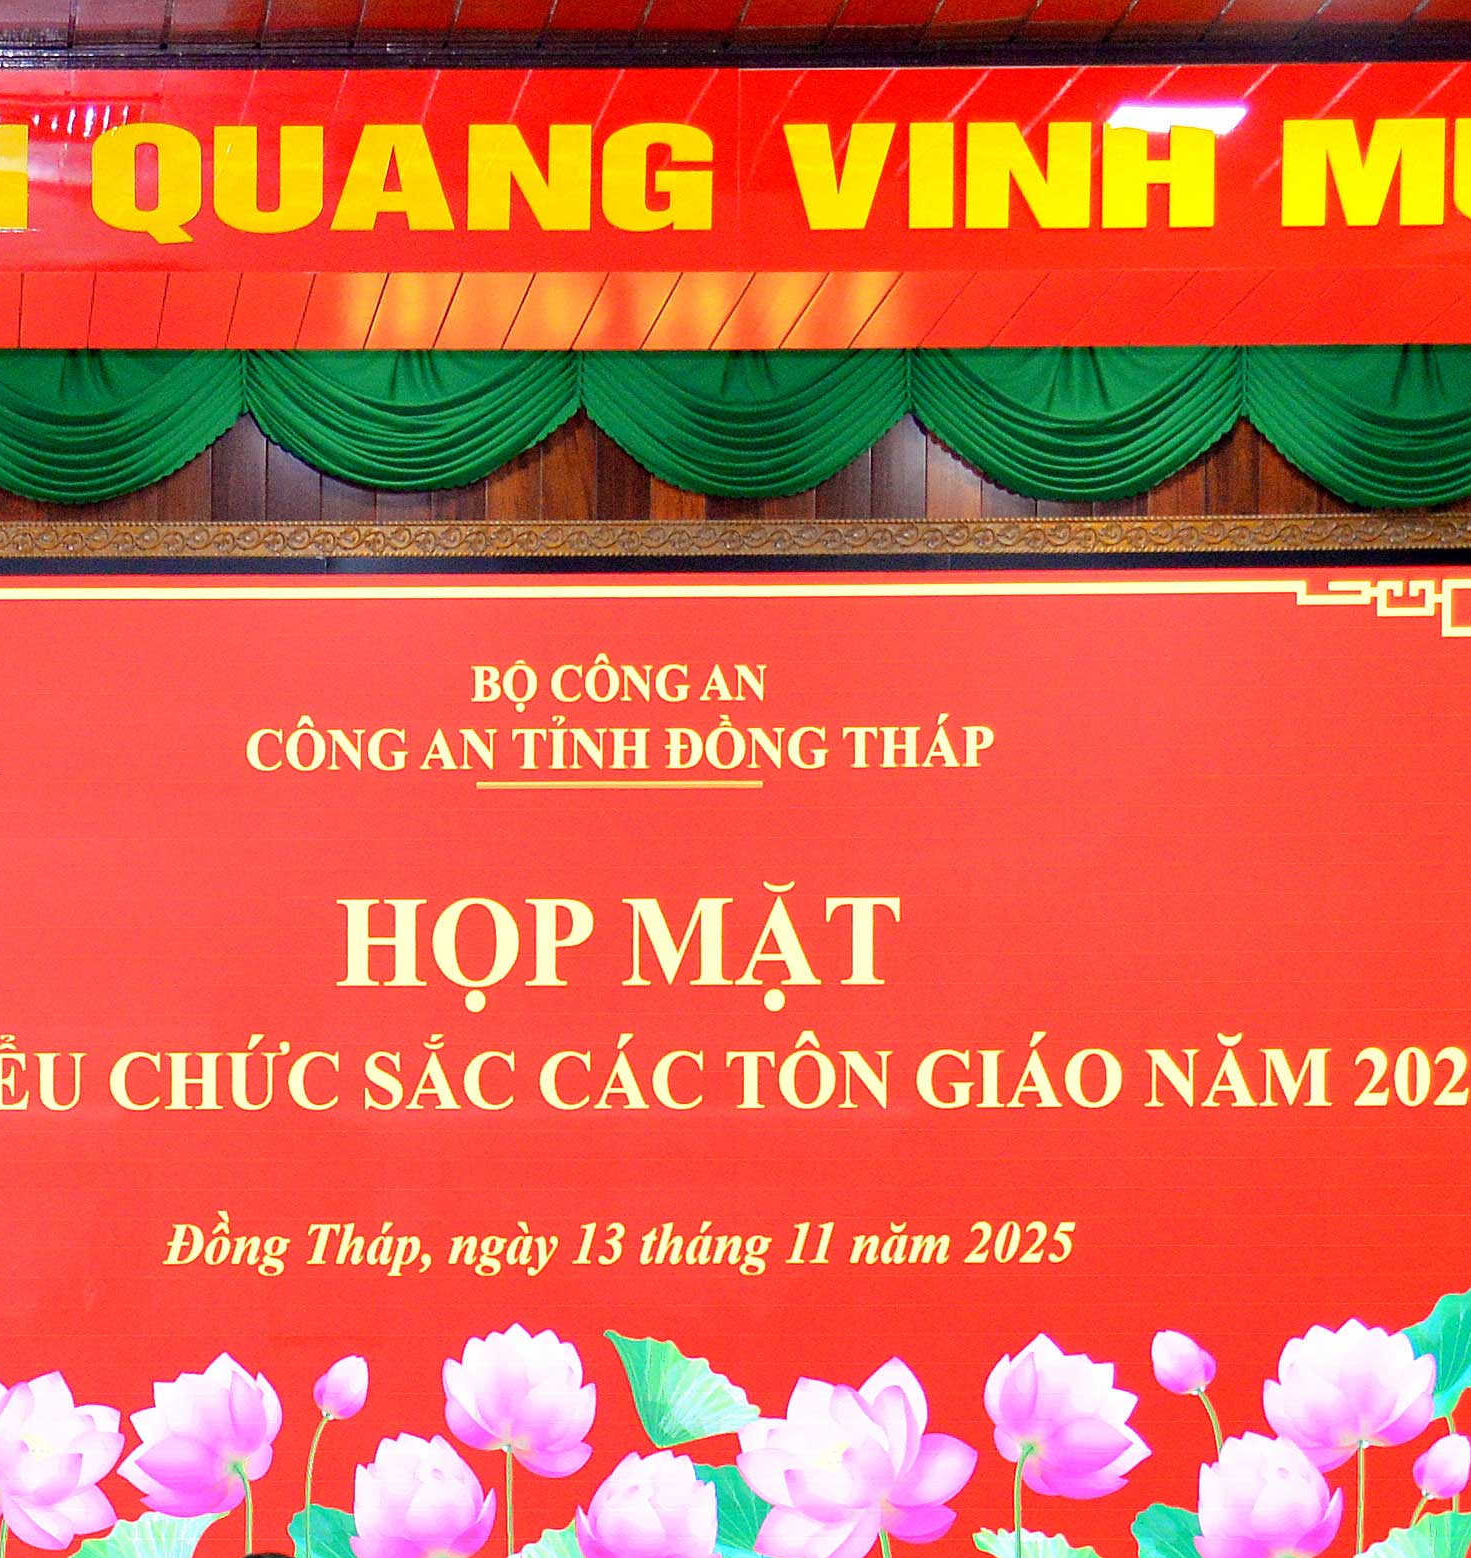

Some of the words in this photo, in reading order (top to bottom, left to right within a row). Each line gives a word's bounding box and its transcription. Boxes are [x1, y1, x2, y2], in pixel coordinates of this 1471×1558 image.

[92, 123, 713, 243] QUANG
[784, 122, 1217, 229] VINH
[471, 660, 537, 712] BỘ
[551, 653, 691, 702] CÔNG
[700, 664, 767, 701] AN
[246, 715, 408, 771] CÔNG
[420, 728, 497, 769] AN
[512, 715, 650, 769] TỈNH
[665, 714, 829, 769] ĐỒNG
[843, 713, 995, 768] THÁP
[336, 898, 594, 1012] HỌP
[622, 881, 900, 1011] MẶT
[110, 1034, 339, 1110] CHỨC
[365, 1034, 515, 1110] SẮC
[540, 1033, 703, 1110] CÁC
[726, 1030, 892, 1109] TÔN
[916, 1031, 1122, 1108] GIÁO
[1144, 1033, 1332, 1107] NĂM
[163, 1211, 291, 1276] Đồng
[307, 1222, 431, 1276] Tháp,
[448, 1221, 558, 1276] ngày
[572, 1222, 625, 1265] 13
[640, 1221, 772, 1275] tháng
[786, 1222, 834, 1263] 11
[850, 1222, 950, 1264] năm
[964, 1221, 1076, 1263] 2025
